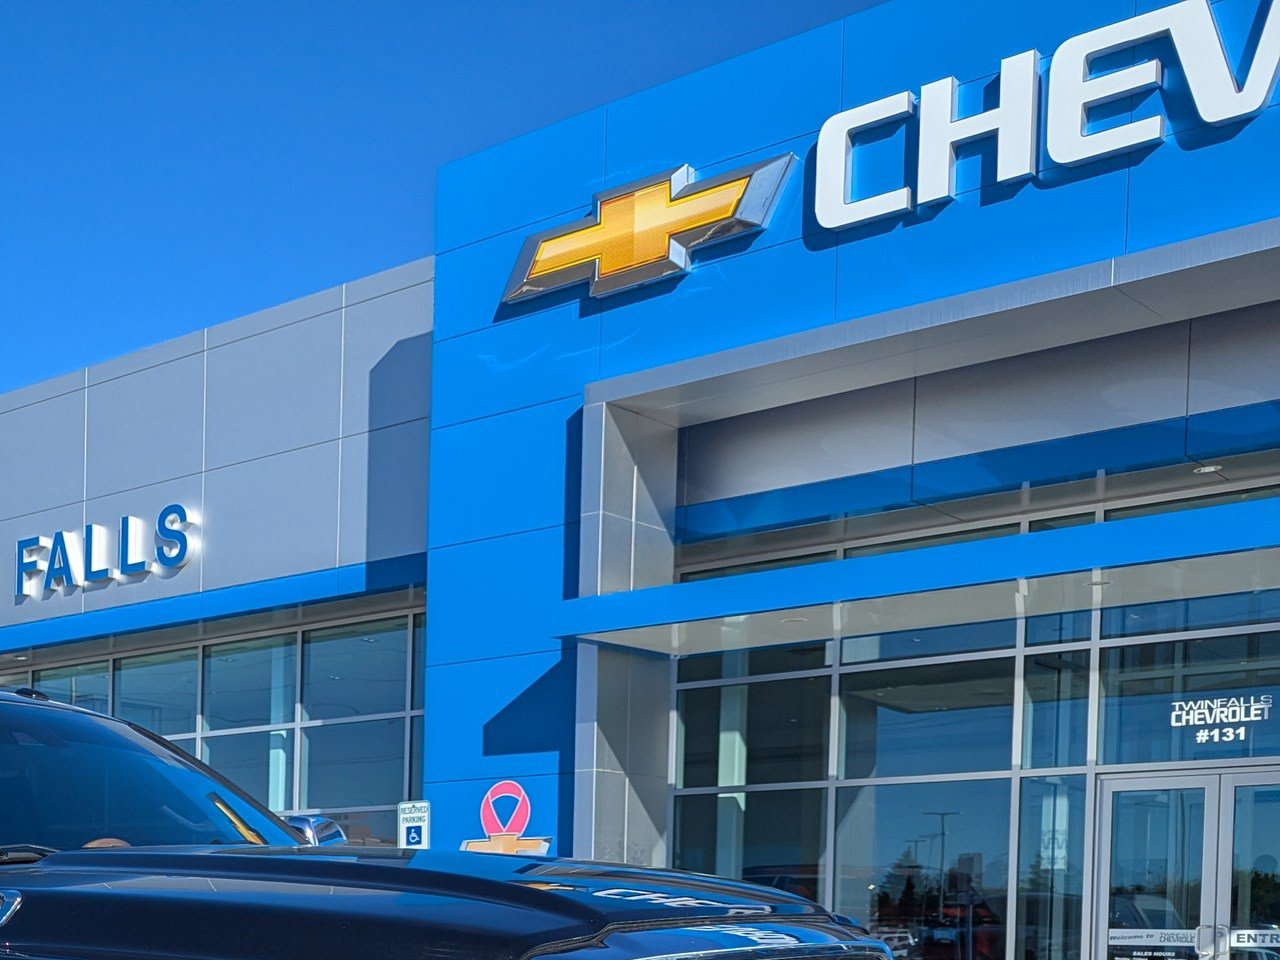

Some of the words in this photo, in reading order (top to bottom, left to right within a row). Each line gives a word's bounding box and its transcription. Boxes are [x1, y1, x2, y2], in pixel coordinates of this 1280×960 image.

[15, 503, 192, 600] FALLS
[1171, 695, 1273, 711] TWINFALLS
[1170, 704, 1272, 727] CHEVROLET
[1195, 726, 1246, 744] #131
[400, 806, 428, 815] RESERVED
[402, 816, 426, 824] PARKING
